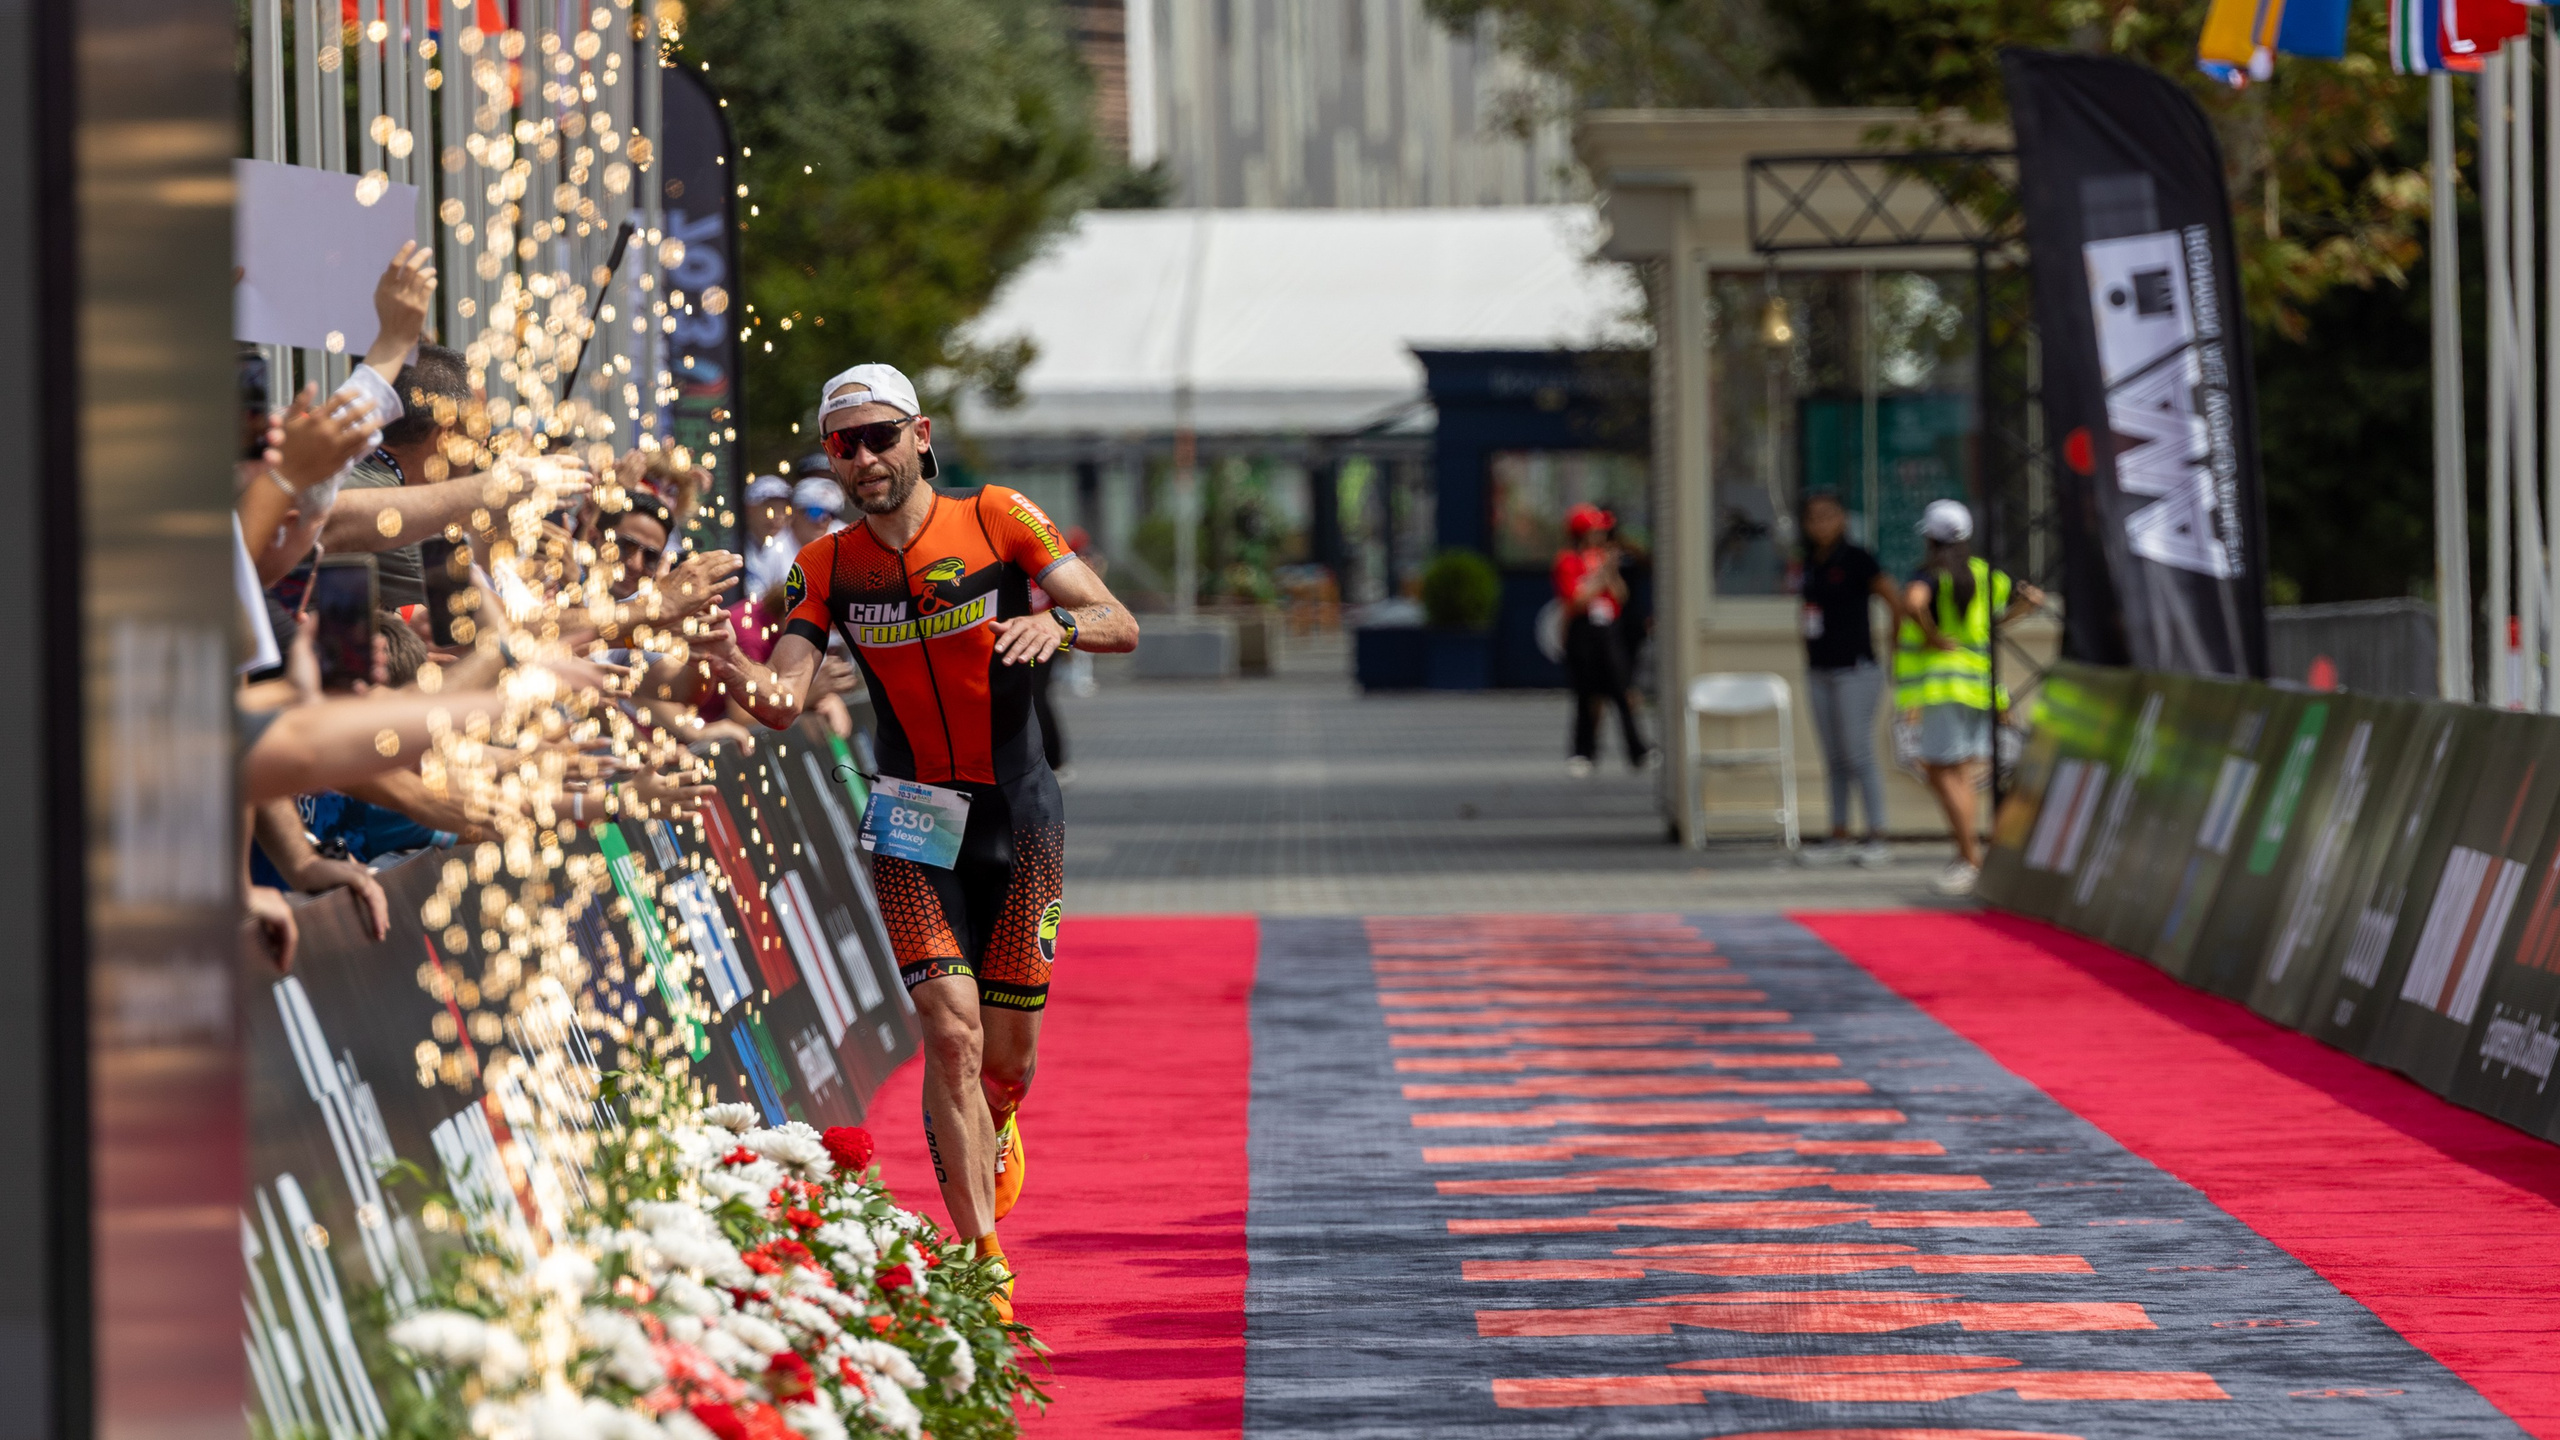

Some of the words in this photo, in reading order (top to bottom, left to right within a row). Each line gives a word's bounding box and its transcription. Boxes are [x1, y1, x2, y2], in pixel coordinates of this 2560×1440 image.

[917, 584, 954, 615] &
[889, 806, 935, 833] 830
[888, 828, 927, 846] Alexey
